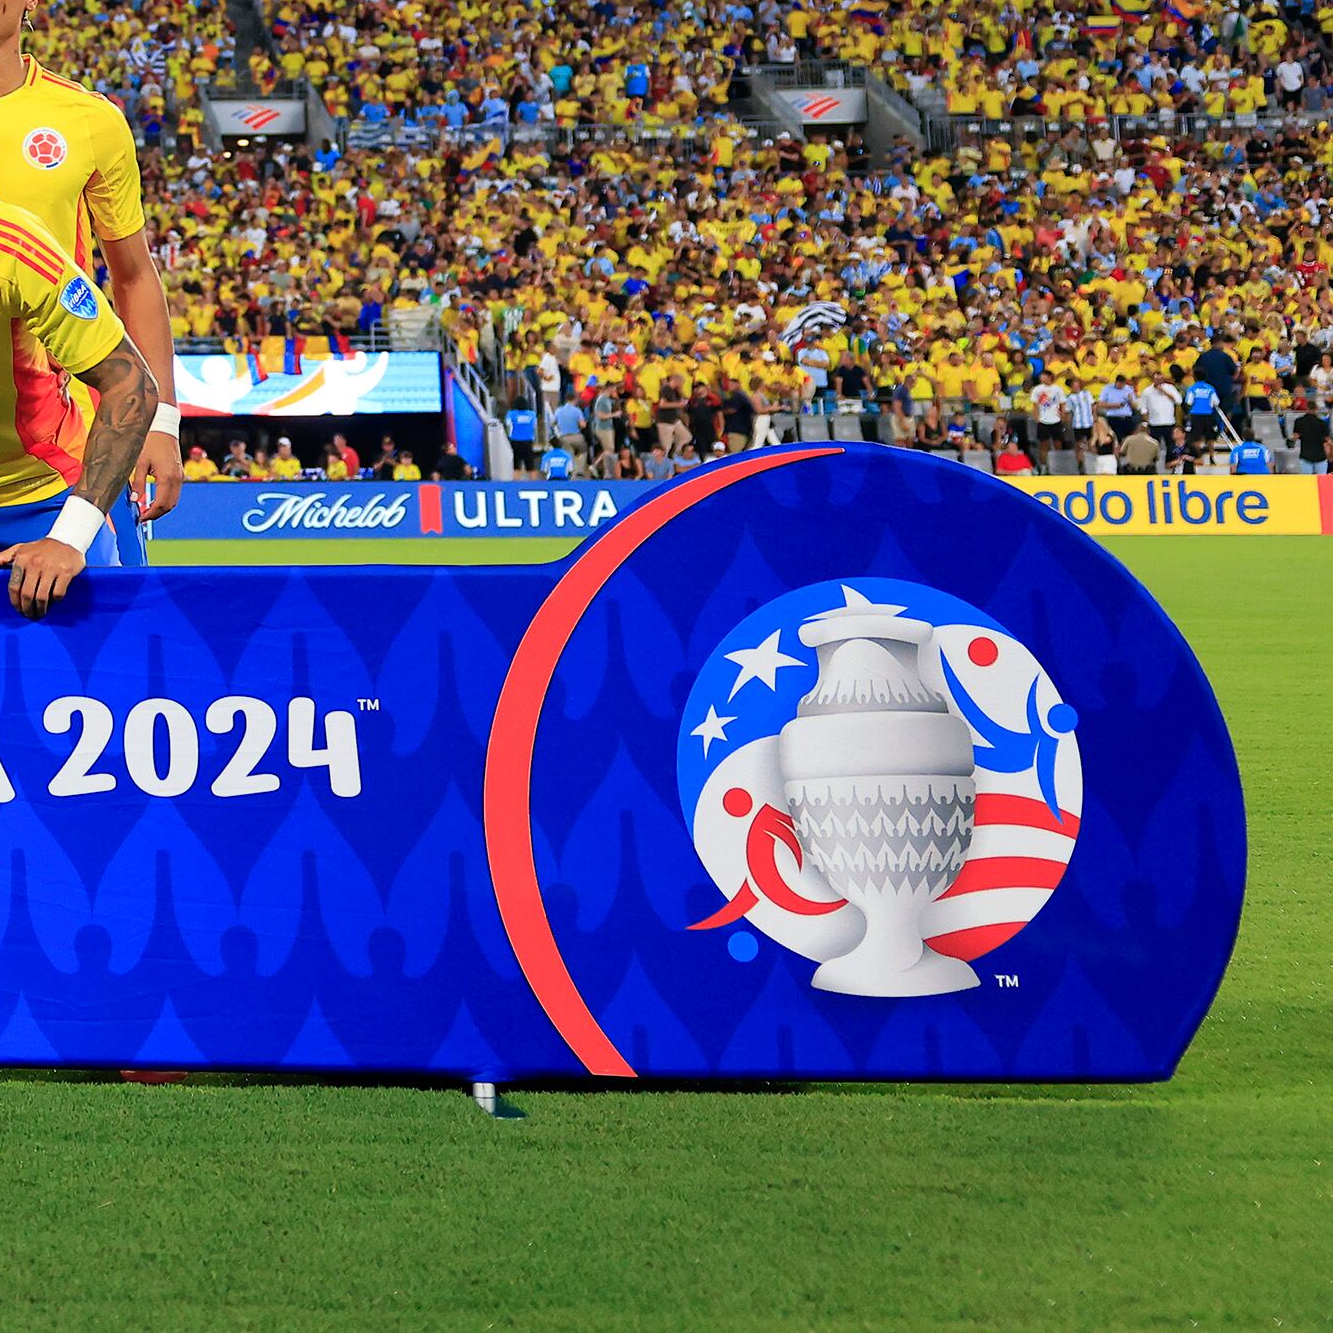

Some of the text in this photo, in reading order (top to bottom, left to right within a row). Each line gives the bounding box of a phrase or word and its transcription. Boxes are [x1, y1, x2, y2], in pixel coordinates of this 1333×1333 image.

[242, 489, 618, 533] Michelob ULTRA
[1147, 479, 1270, 525] libre
[44, 696, 362, 798] 2024
[994, 974, 1019, 988] TM
